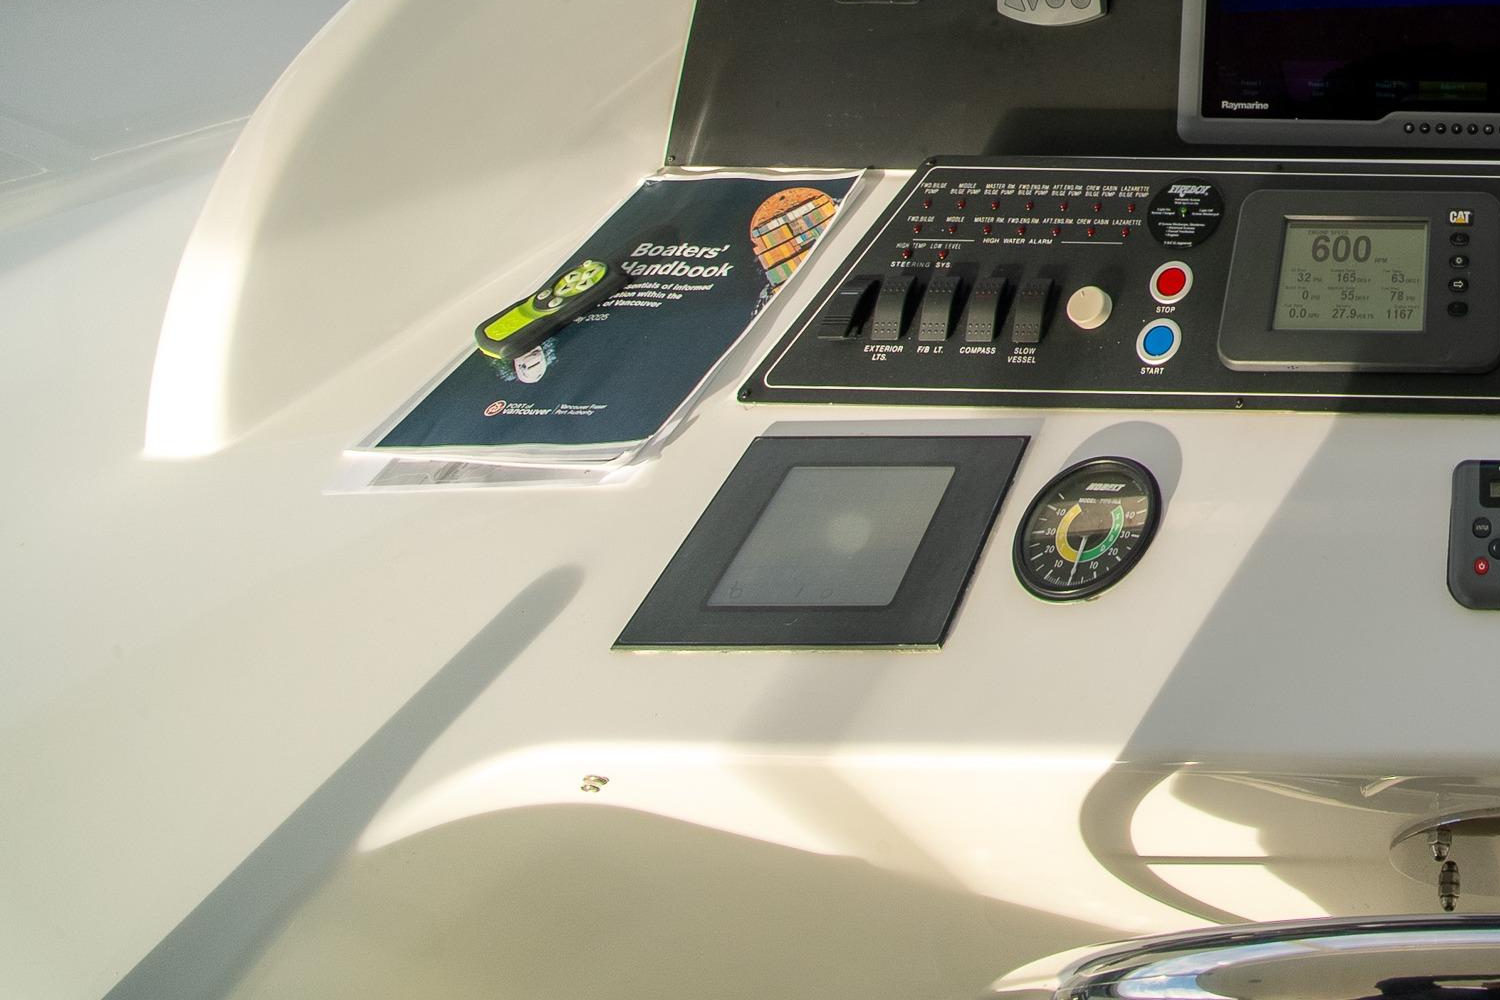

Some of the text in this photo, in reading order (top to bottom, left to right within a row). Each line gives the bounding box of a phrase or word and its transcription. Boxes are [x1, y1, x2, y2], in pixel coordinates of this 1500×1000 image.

[1221, 100, 1269, 111] Raymarine
[1168, 184, 1212, 197] FIREBOY
[1449, 211, 1471, 224] CAT
[1311, 234, 1372, 263] 600
[621, 261, 734, 278] Handbook
[1297, 272, 1311, 282] 32
[1337, 272, 1356, 283] 165
[1391, 274, 1405, 283] 63
[661, 282, 673, 290] of
[673, 283, 714, 291] informed
[637, 291, 683, 300] within the
[1341, 290, 1354, 300] 55
[602, 299, 663, 308] of Vancouver
[1289, 308, 1307, 318] 0.0
[1332, 308, 1357, 319] 27.9
[1387, 309, 1413, 319] 1167
[864, 345, 904, 353] EXTERIOR
[917, 345, 930, 354] F/B
[959, 347, 996, 355] COMPASS
[1014, 347, 1036, 355] SLOW
[872, 353, 887, 361] LTS.
[1007, 356, 1036, 364] VESSEL
[1140, 367, 1165, 375] START
[1055, 508, 1066, 516] 40
[1125, 511, 1136, 519] 40
[1046, 528, 1056, 536] 30
[1120, 531, 1130, 539] 30
[1108, 548, 1118, 556] 20
[1054, 559, 1063, 568] 10
[1090, 561, 1098, 569] 10
